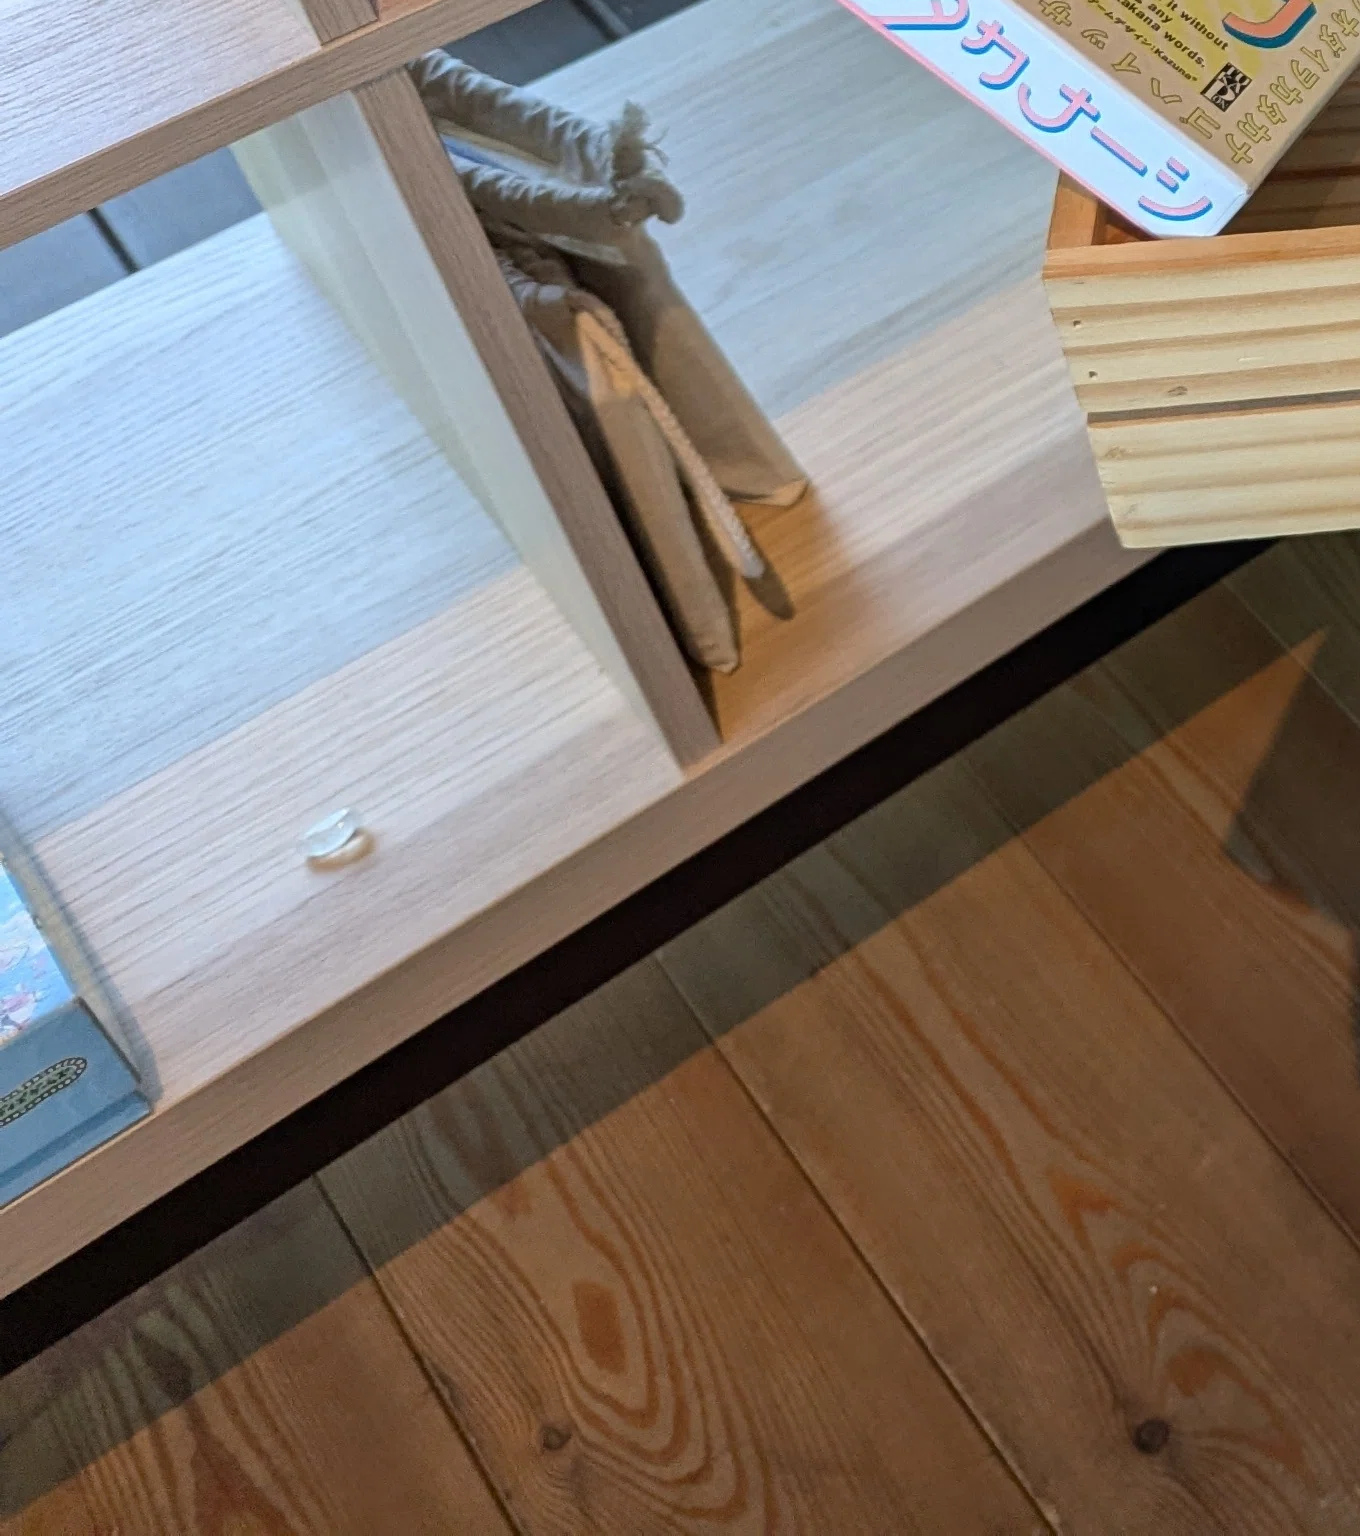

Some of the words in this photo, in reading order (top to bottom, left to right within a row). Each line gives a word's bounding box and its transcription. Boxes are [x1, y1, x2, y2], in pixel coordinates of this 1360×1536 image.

[1148, 2, 1174, 24] any
[1166, 0, 1179, 12] it
[1180, 10, 1229, 52] without
[1164, 30, 1207, 69] words.
